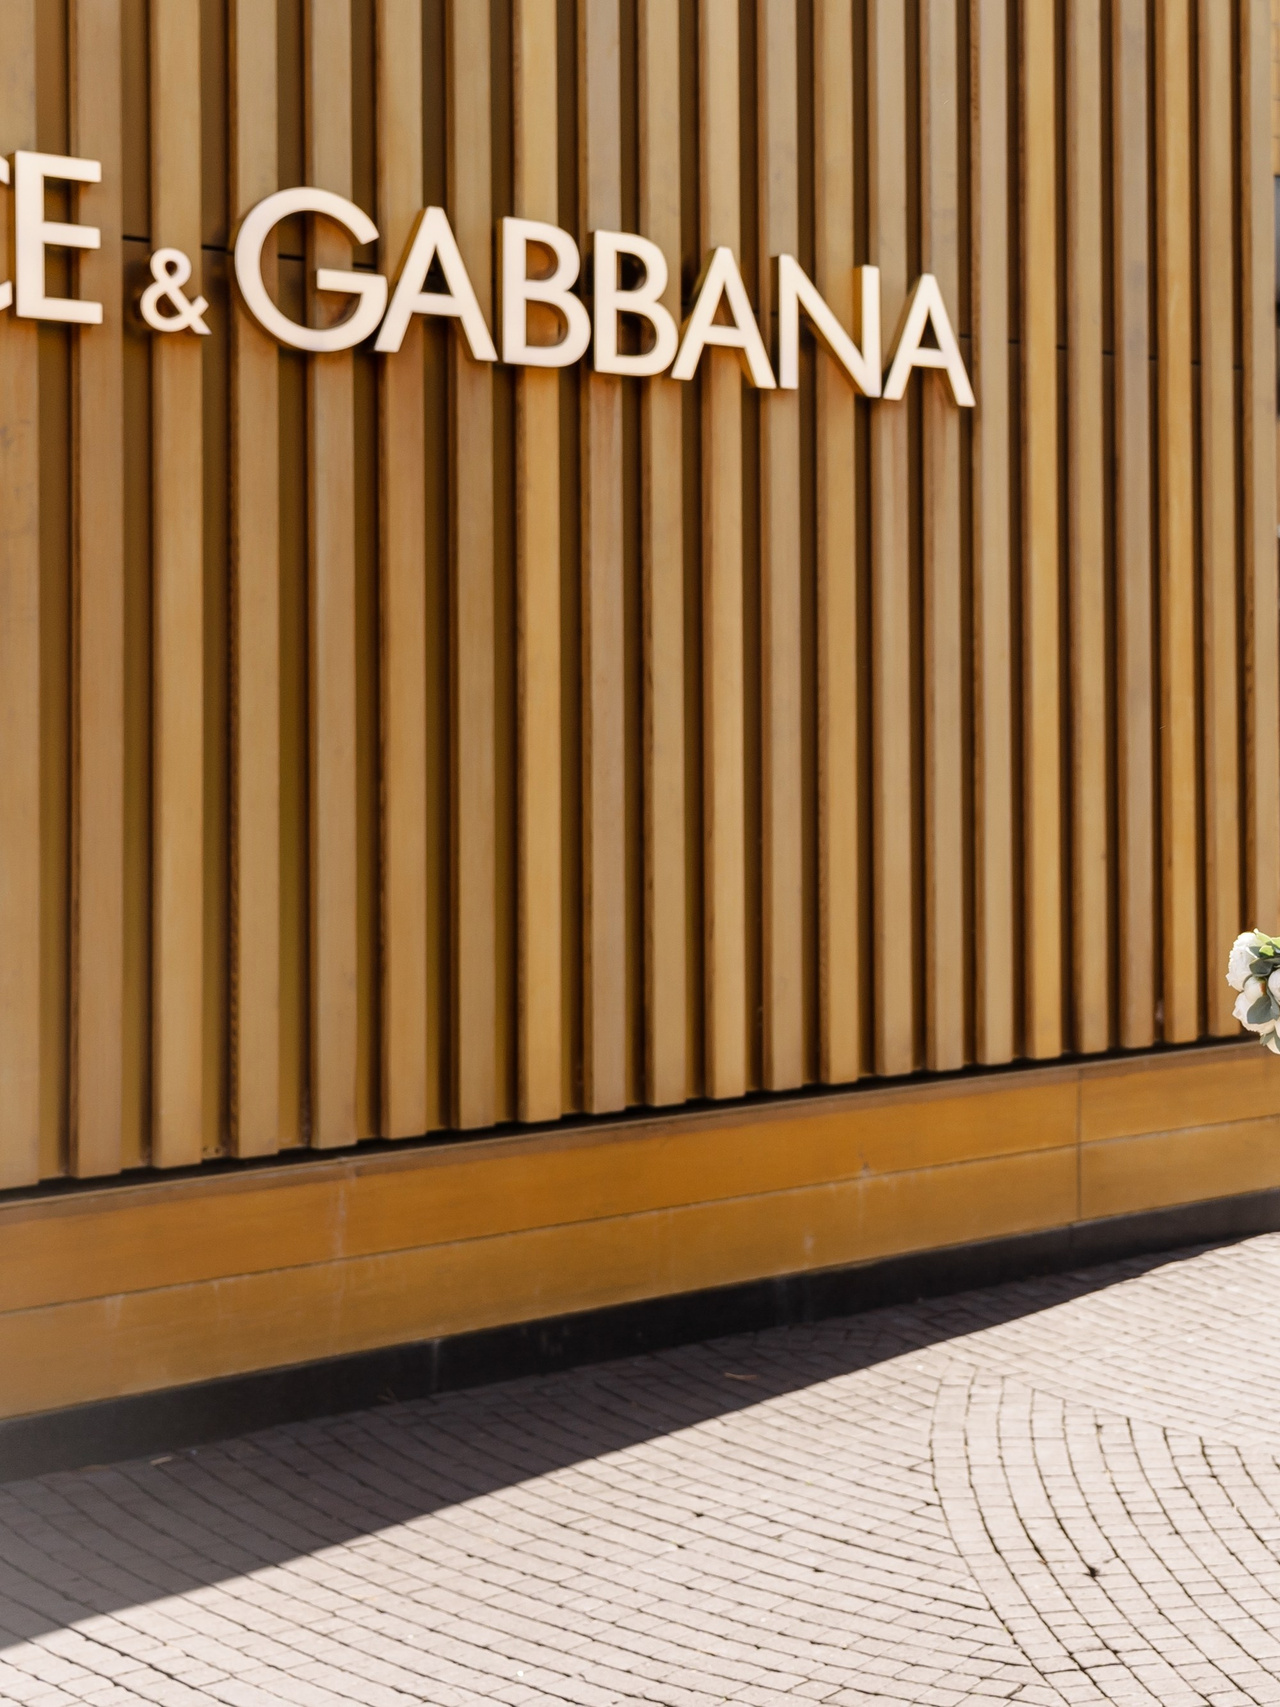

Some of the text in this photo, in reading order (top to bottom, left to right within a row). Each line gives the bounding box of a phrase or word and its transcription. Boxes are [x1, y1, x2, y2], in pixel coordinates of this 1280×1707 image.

[0, 150, 976, 407] E & GABBANA
